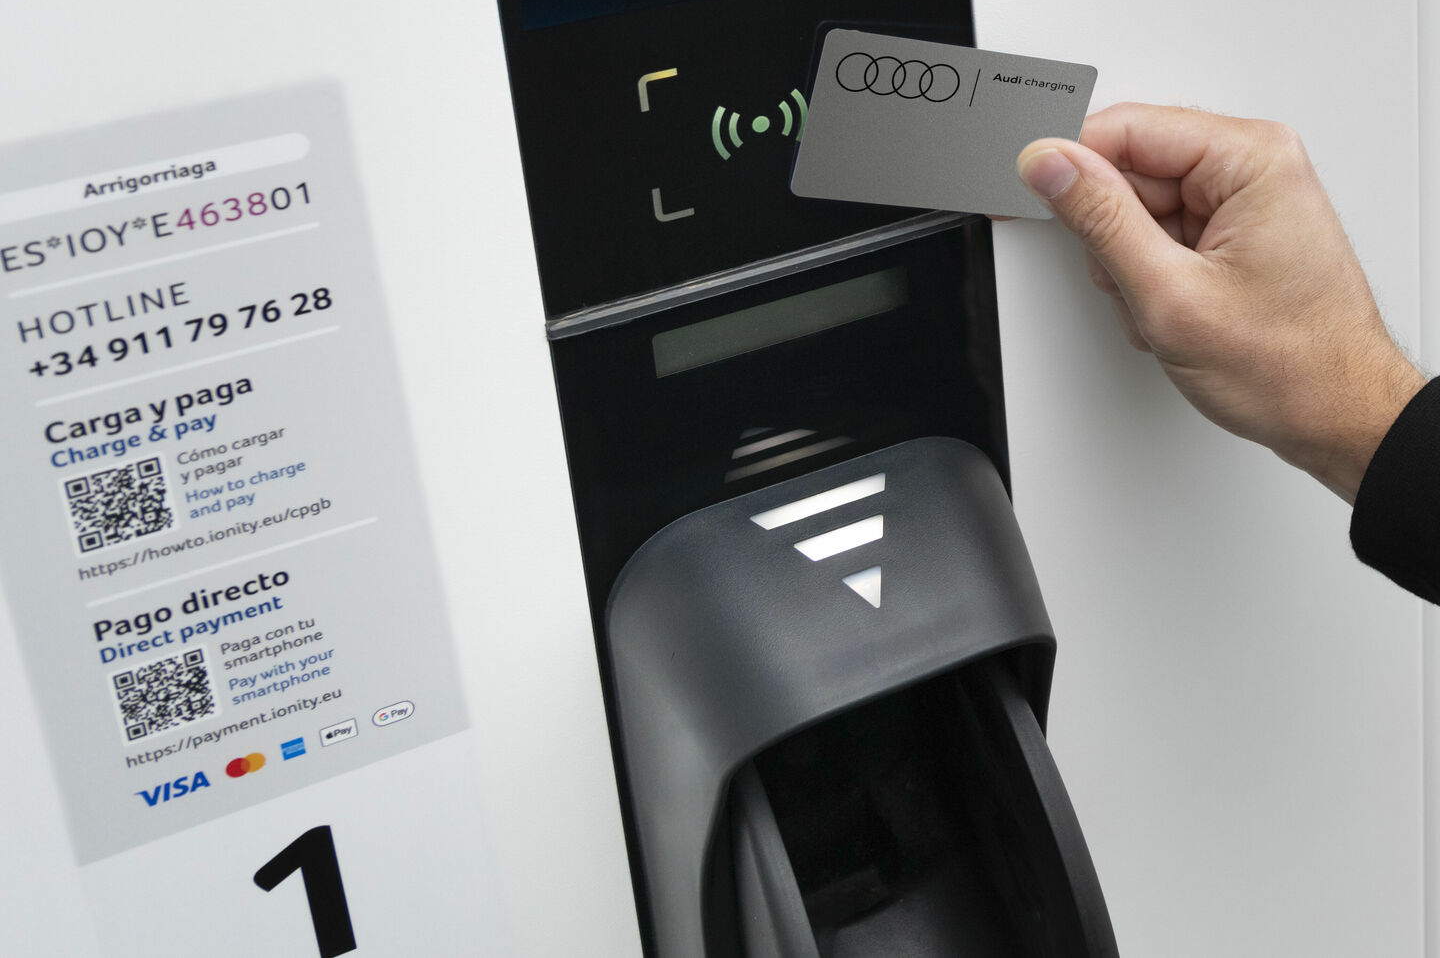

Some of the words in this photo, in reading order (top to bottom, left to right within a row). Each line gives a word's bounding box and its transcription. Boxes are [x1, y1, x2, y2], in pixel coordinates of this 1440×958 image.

[993, 73, 1022, 84] Audi
[1024, 78, 1076, 94] charging
[83, 159, 217, 198] Arrigorriaga
[17, 282, 190, 343] HOTLINE
[29, 345, 99, 377] +34
[108, 326, 173, 362] 911
[184, 313, 229, 343] 79
[238, 299, 281, 329] 76
[290, 287, 333, 316] 28
[44, 406, 142, 444] Carga
[148, 399, 168, 424] y
[175, 377, 254, 416] paga
[50, 434, 142, 468] Charge
[148, 424, 168, 442] &
[174, 413, 217, 440] pay
[176, 444, 229, 466] Cómo
[231, 427, 286, 450] cargar
[179, 471, 191, 485] y
[194, 455, 243, 480] pagar
[185, 485, 225, 503] How
[227, 479, 246, 492] to
[249, 462, 307, 485] charge
[189, 499, 222, 519] and
[226, 492, 256, 511] pay
[78, 498, 332, 580] https://howto.ionity.eu/cpgb
[93, 606, 173, 642] Pago
[181, 570, 290, 615] directo
[99, 630, 175, 664] Direct
[180, 596, 284, 643] payment
[220, 635, 262, 655] Paga
[265, 624, 295, 641] con
[298, 618, 316, 631] tu
[224, 631, 324, 670] smartphone
[228, 674, 257, 690] Pay
[260, 660, 296, 680] with
[299, 648, 335, 671] your
[232, 666, 331, 705] smartphone
[125, 688, 342, 768] https://payment.ionity.eu
[333, 725, 353, 738] Pay
[390, 706, 409, 718] Pay
[133, 771, 211, 807] VISA
[253, 825, 357, 958] 1
